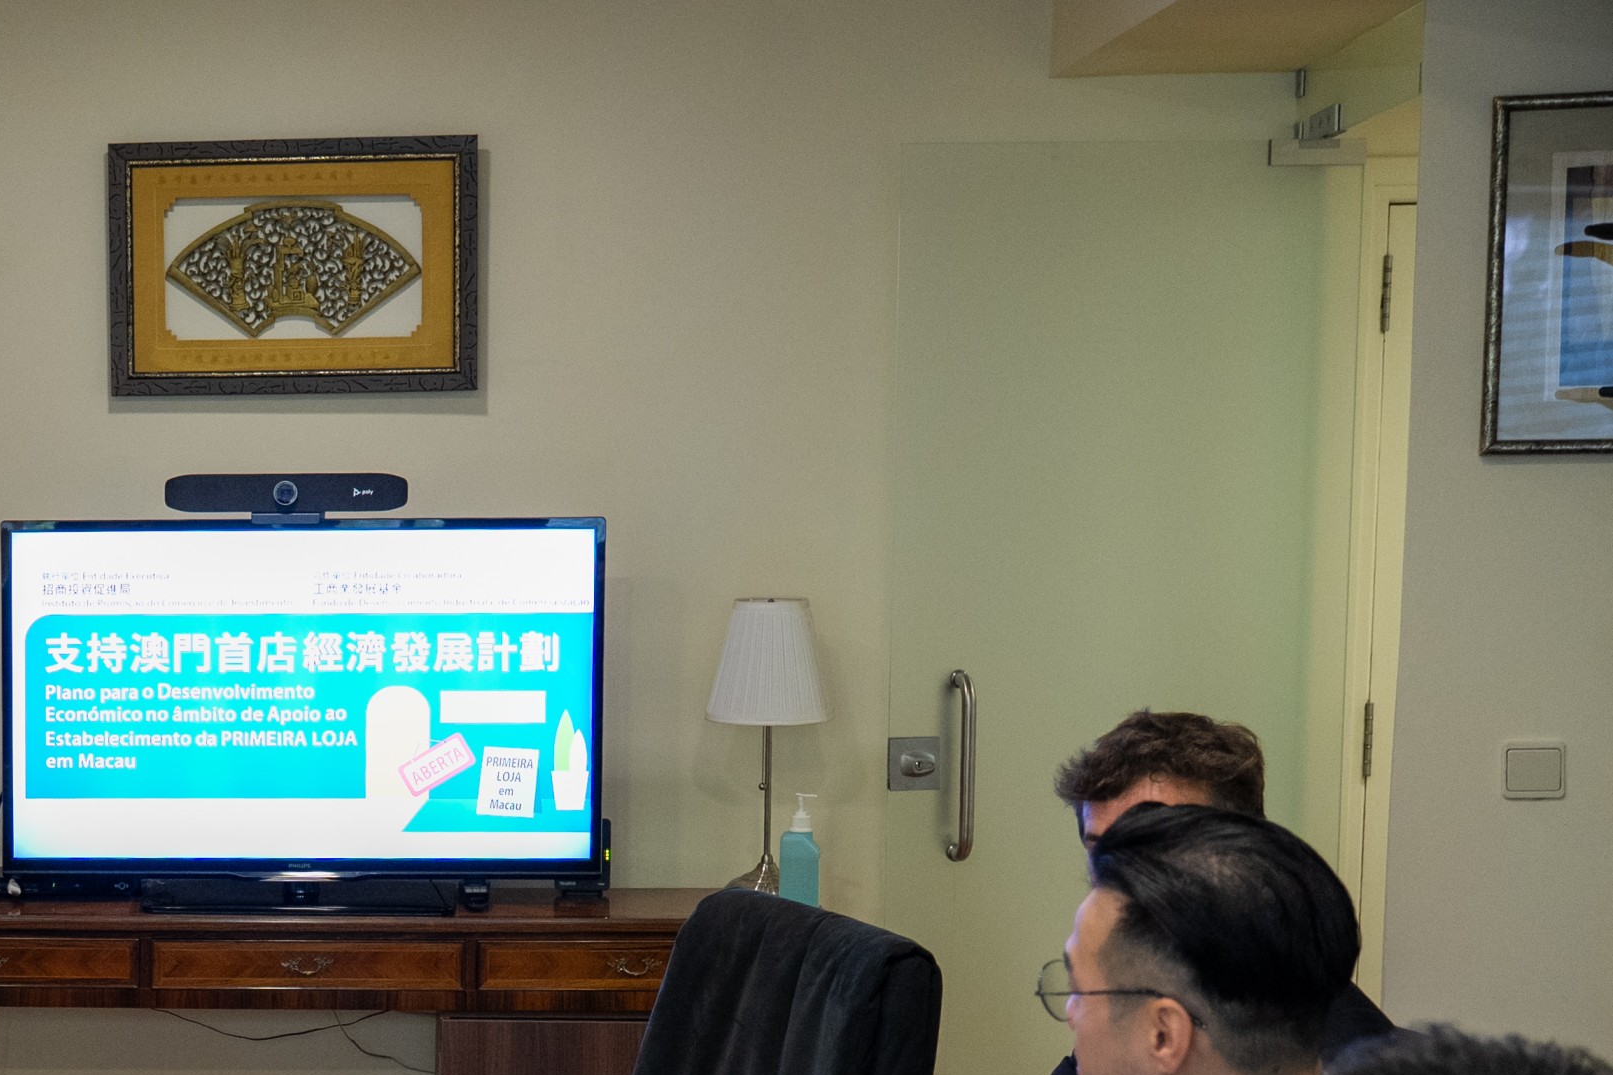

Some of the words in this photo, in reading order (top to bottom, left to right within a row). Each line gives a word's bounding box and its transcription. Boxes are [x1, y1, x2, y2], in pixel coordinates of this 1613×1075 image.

[82, 572, 123, 581] Entdade
[44, 631, 560, 674] 支持澳門首店經濟發展計劃
[45, 685, 96, 700] Plano
[100, 688, 138, 703] para
[142, 688, 154, 700] o
[157, 683, 315, 700] Desenvolvimento
[45, 706, 142, 722] Económico
[146, 709, 168, 722] no
[172, 706, 237, 722] âmbito
[240, 706, 264, 722] de
[267, 706, 321, 725] Apoio
[325, 708, 347, 722] ao
[45, 731, 192, 747] Estabelecimento
[195, 731, 217, 747] da
[221, 730, 307, 747] PRIMEIRA
[312, 730, 358, 747] LOJA
[45, 756, 73, 768] em
[78, 753, 136, 768] Macau
[411, 746, 465, 786] ABERTA
[486, 756, 533, 770] PRIMEIRA
[496, 771, 522, 783] LOJA
[498, 787, 514, 796] em
[490, 799, 522, 811] Macau
